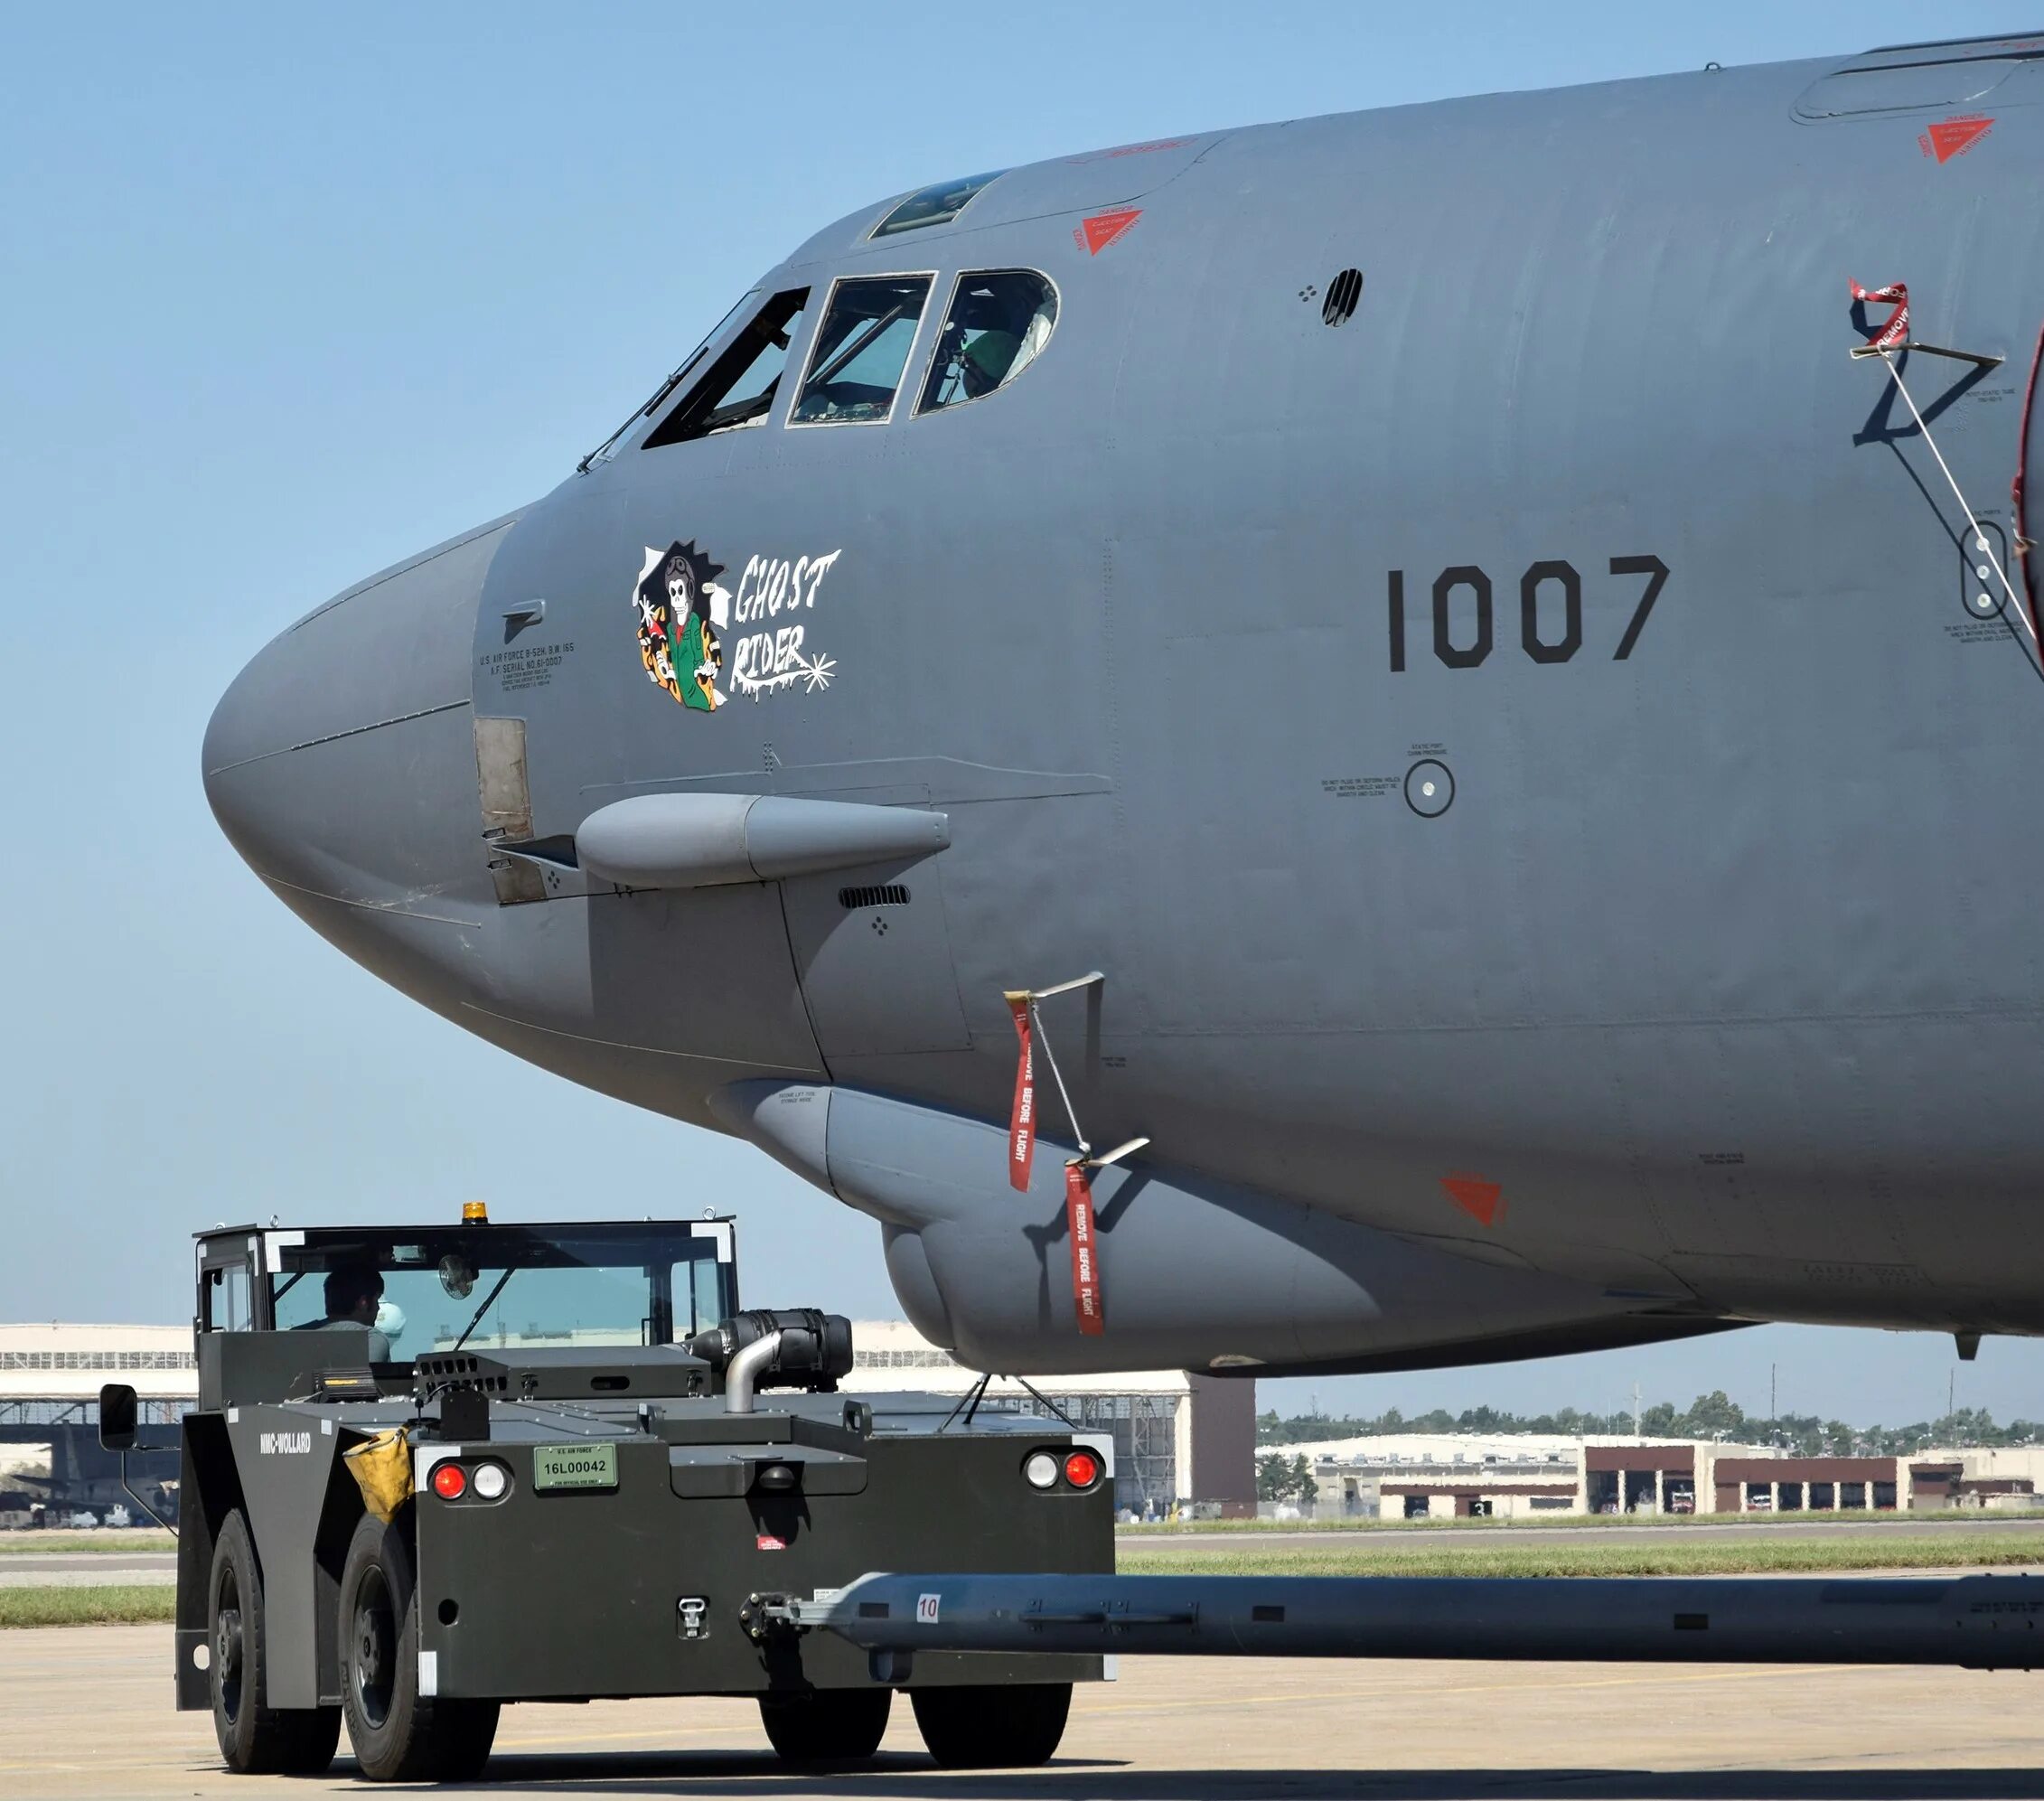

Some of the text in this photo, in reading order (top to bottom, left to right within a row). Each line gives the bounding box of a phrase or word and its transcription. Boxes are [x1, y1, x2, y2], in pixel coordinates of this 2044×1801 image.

[735, 549, 842, 623] GHOST
[1388, 554, 1670, 672] 1007
[492, 652, 502, 663] AIR
[503, 650, 524, 661] FORCE
[502, 661, 525, 673] SERIAL
[729, 624, 815, 698] RIDER
[1019, 1087, 1033, 1124] BEFORE
[1016, 1130, 1028, 1163] FLIGHT
[1075, 1204, 1094, 1317] REMOVE BEFORE FLIGHT
[260, 1432, 311, 1454] NMC-WOLLARD
[544, 1460, 605, 1475] 16L00042
[919, 1598, 937, 1618] 10
